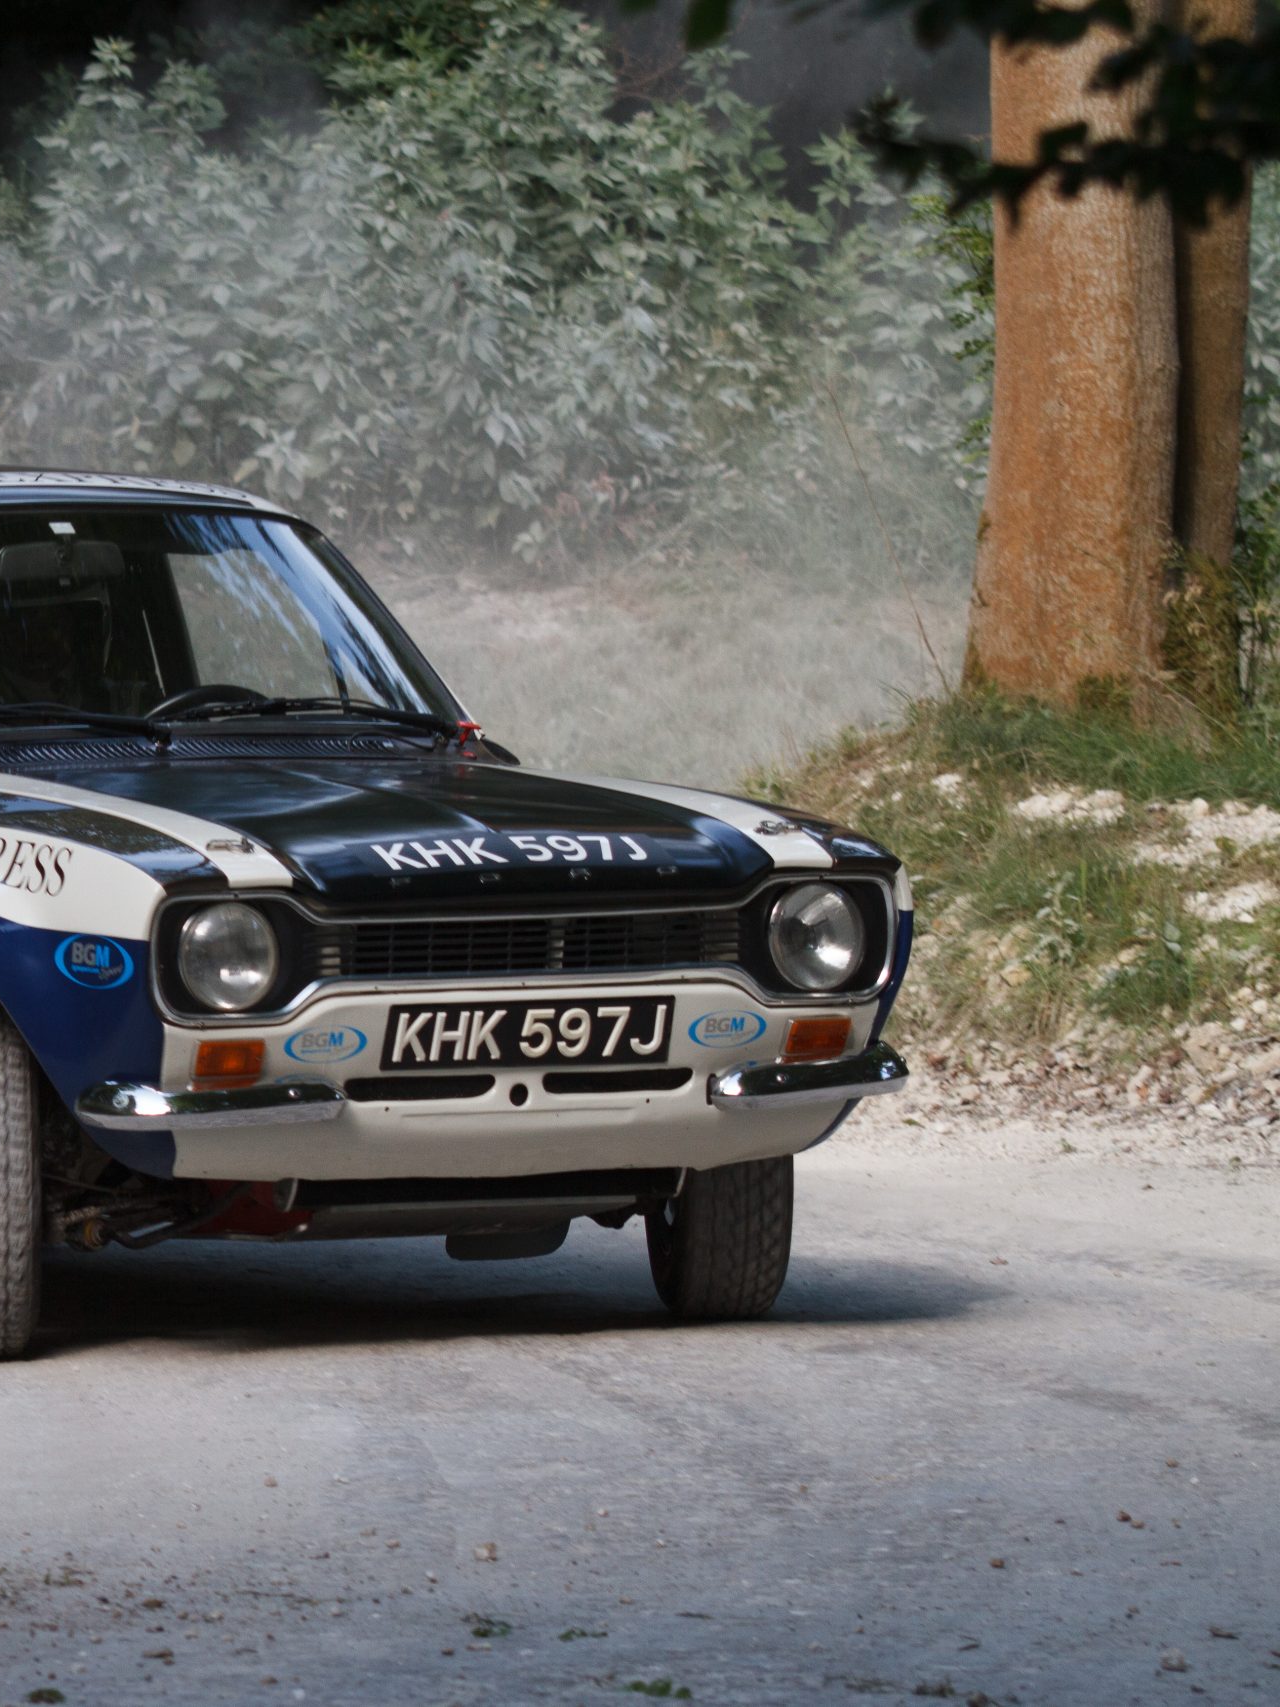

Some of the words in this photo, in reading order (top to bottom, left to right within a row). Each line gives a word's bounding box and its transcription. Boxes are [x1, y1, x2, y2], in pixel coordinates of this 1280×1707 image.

[370, 837, 510, 871] KHK
[508, 835, 648, 862] 597J
[71, 941, 110, 968] BGM
[391, 1009, 508, 1063] KHK
[519, 1004, 668, 1059] 597J
[705, 1016, 746, 1033] BGM
